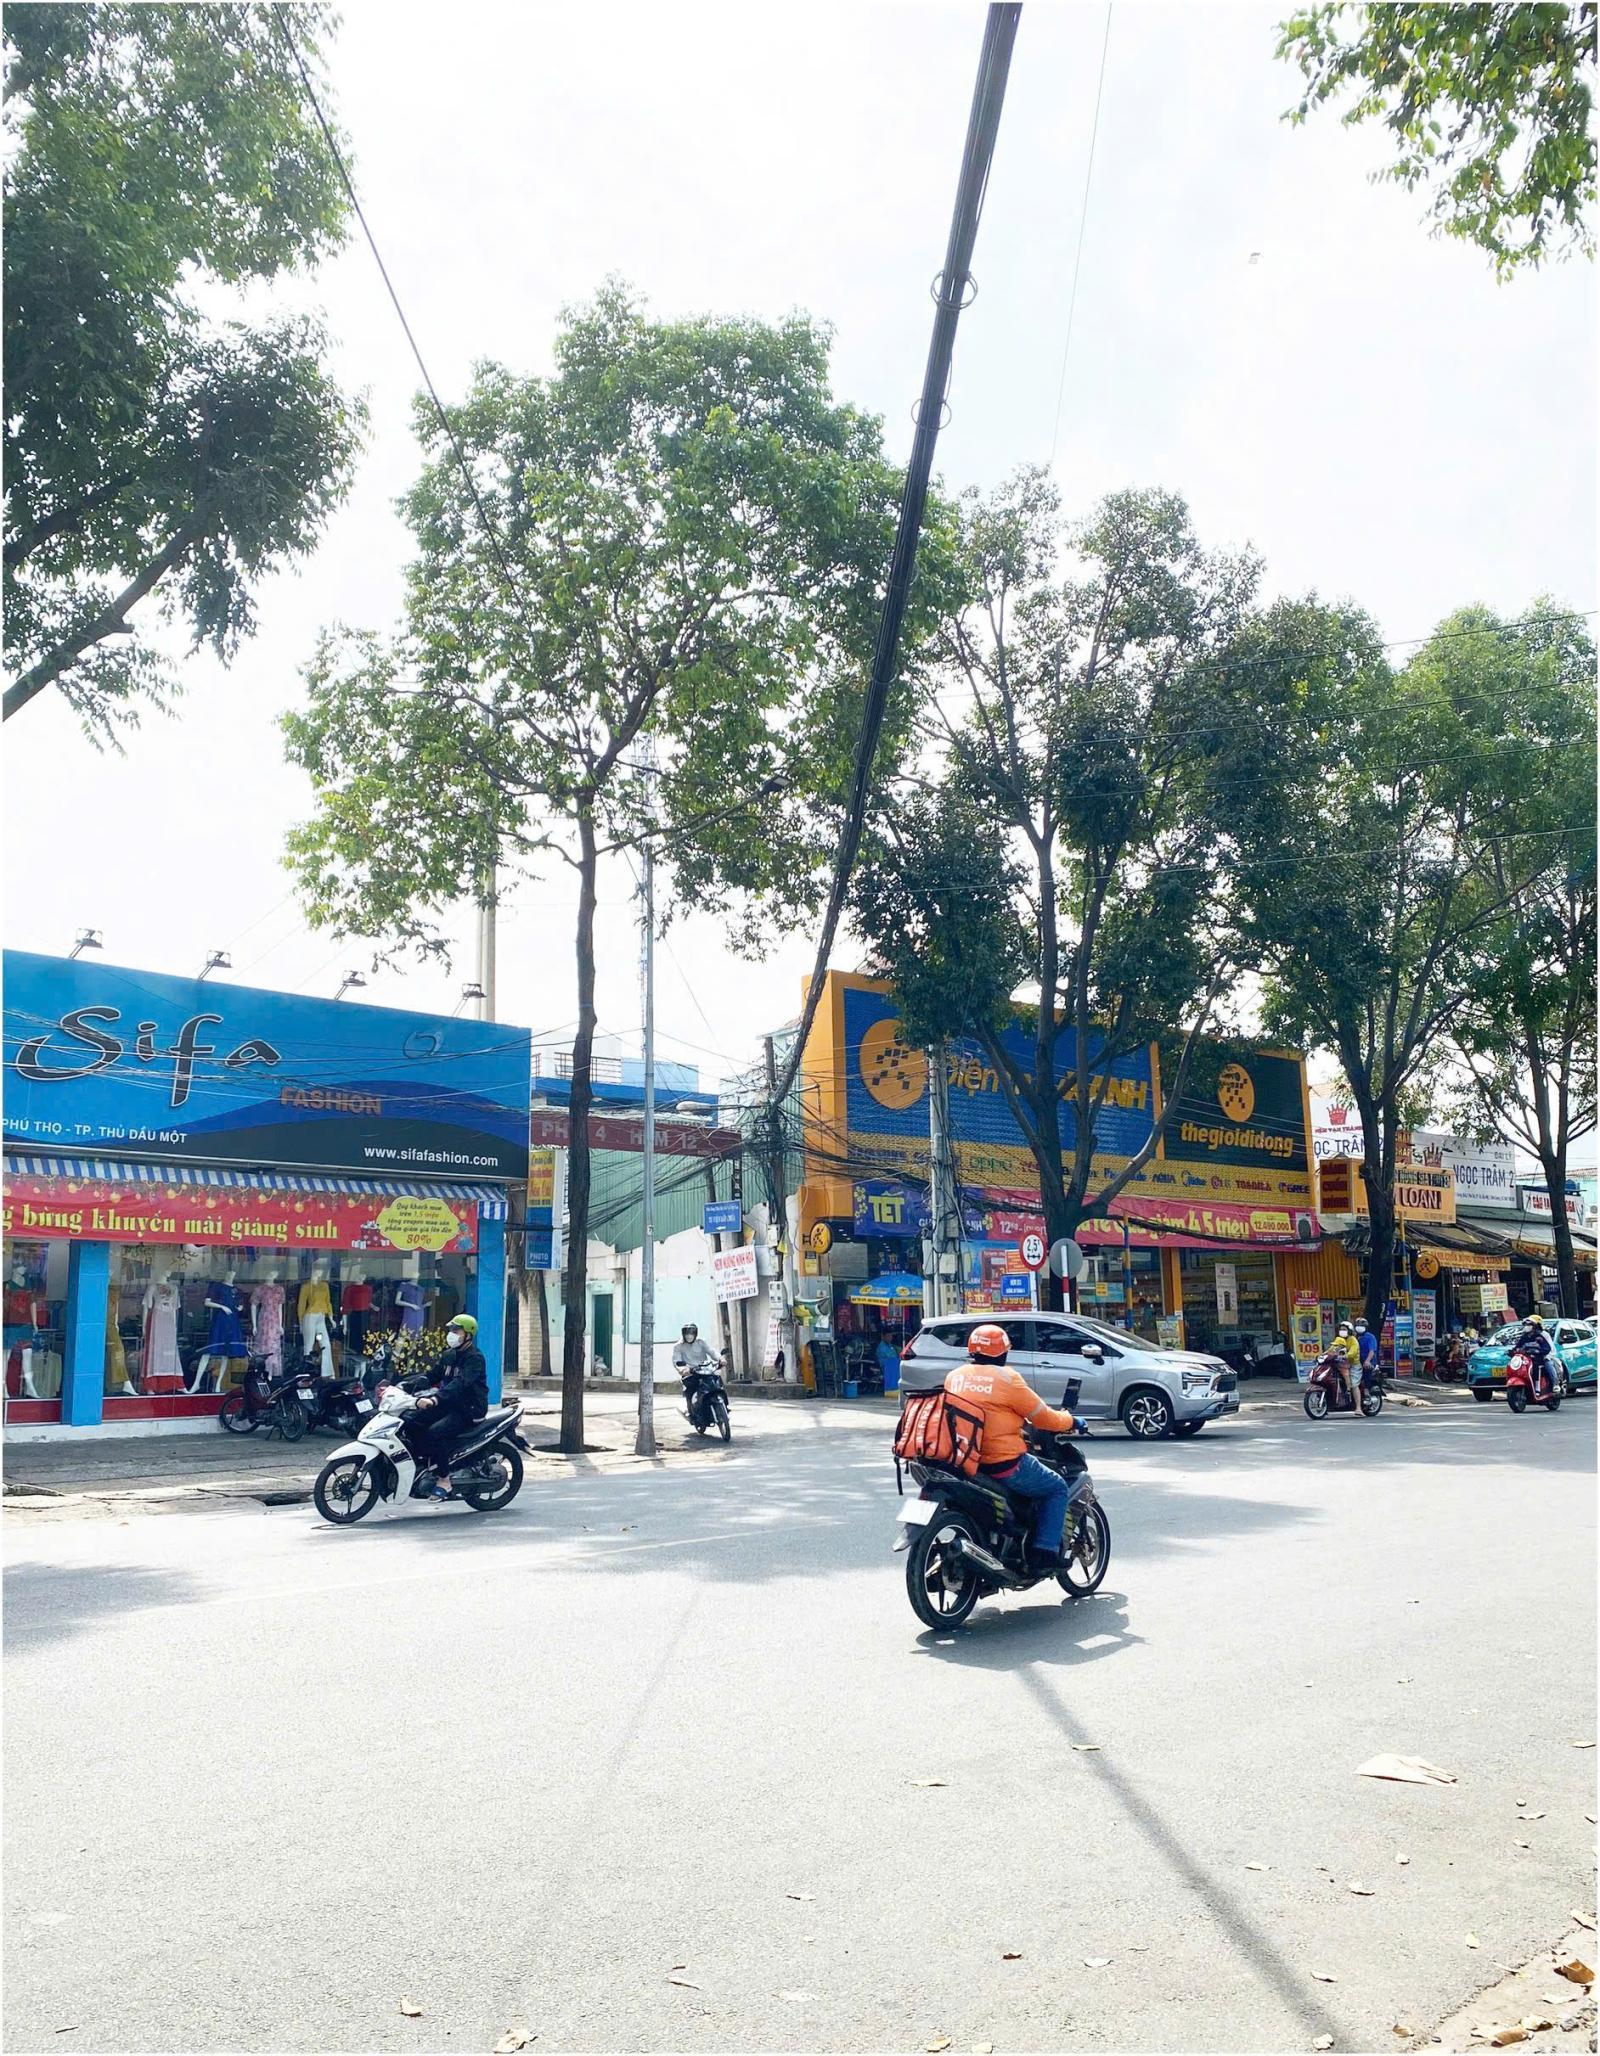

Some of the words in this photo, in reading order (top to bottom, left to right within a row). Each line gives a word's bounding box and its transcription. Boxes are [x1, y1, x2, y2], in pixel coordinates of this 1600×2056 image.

[16, 1006, 281, 1107] Sifa
[279, 1086, 382, 1117] FASHION
[34, 1121, 62, 1134] THỌ
[99, 1124, 125, 1138] THỦ
[159, 1130, 187, 1144] MỘT
[1181, 1121, 1293, 1158] thegioididong
[364, 1146, 499, 1167] www.sifafashion.com
[22, 1204, 84, 1234] bừng
[92, 1207, 176, 1238] khuyến
[231, 1216, 289, 1242] giáng
[295, 1219, 338, 1240] sinh
[868, 1191, 905, 1224] TẾT
[1415, 1321, 1434, 1330] 650
[964, 1382, 993, 1396] Food
